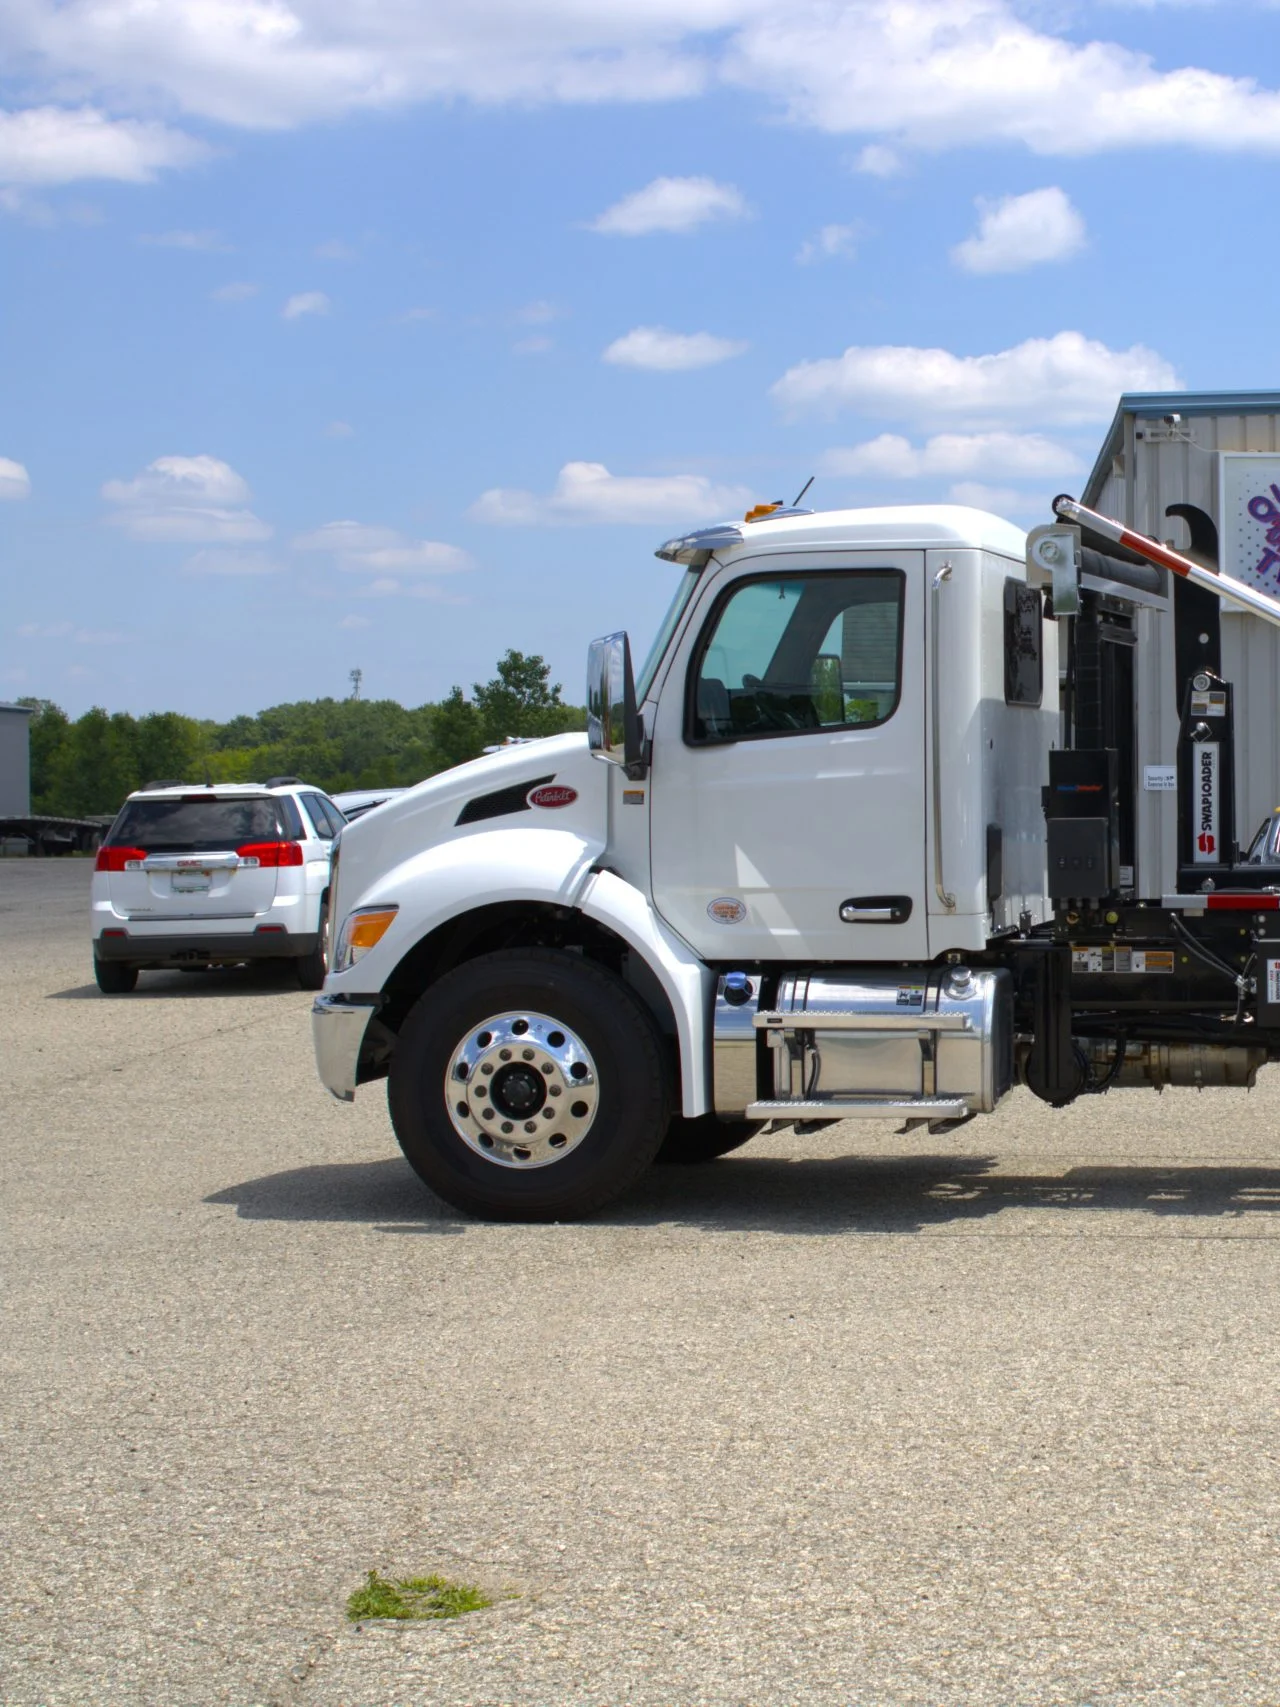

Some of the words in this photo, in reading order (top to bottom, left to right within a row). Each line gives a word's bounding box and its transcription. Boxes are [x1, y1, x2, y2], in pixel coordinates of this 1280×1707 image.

[535, 789, 572, 803] Peterbilt
[1201, 751, 1213, 831] SWAPLOADER
[176, 860, 203, 868] GMC
